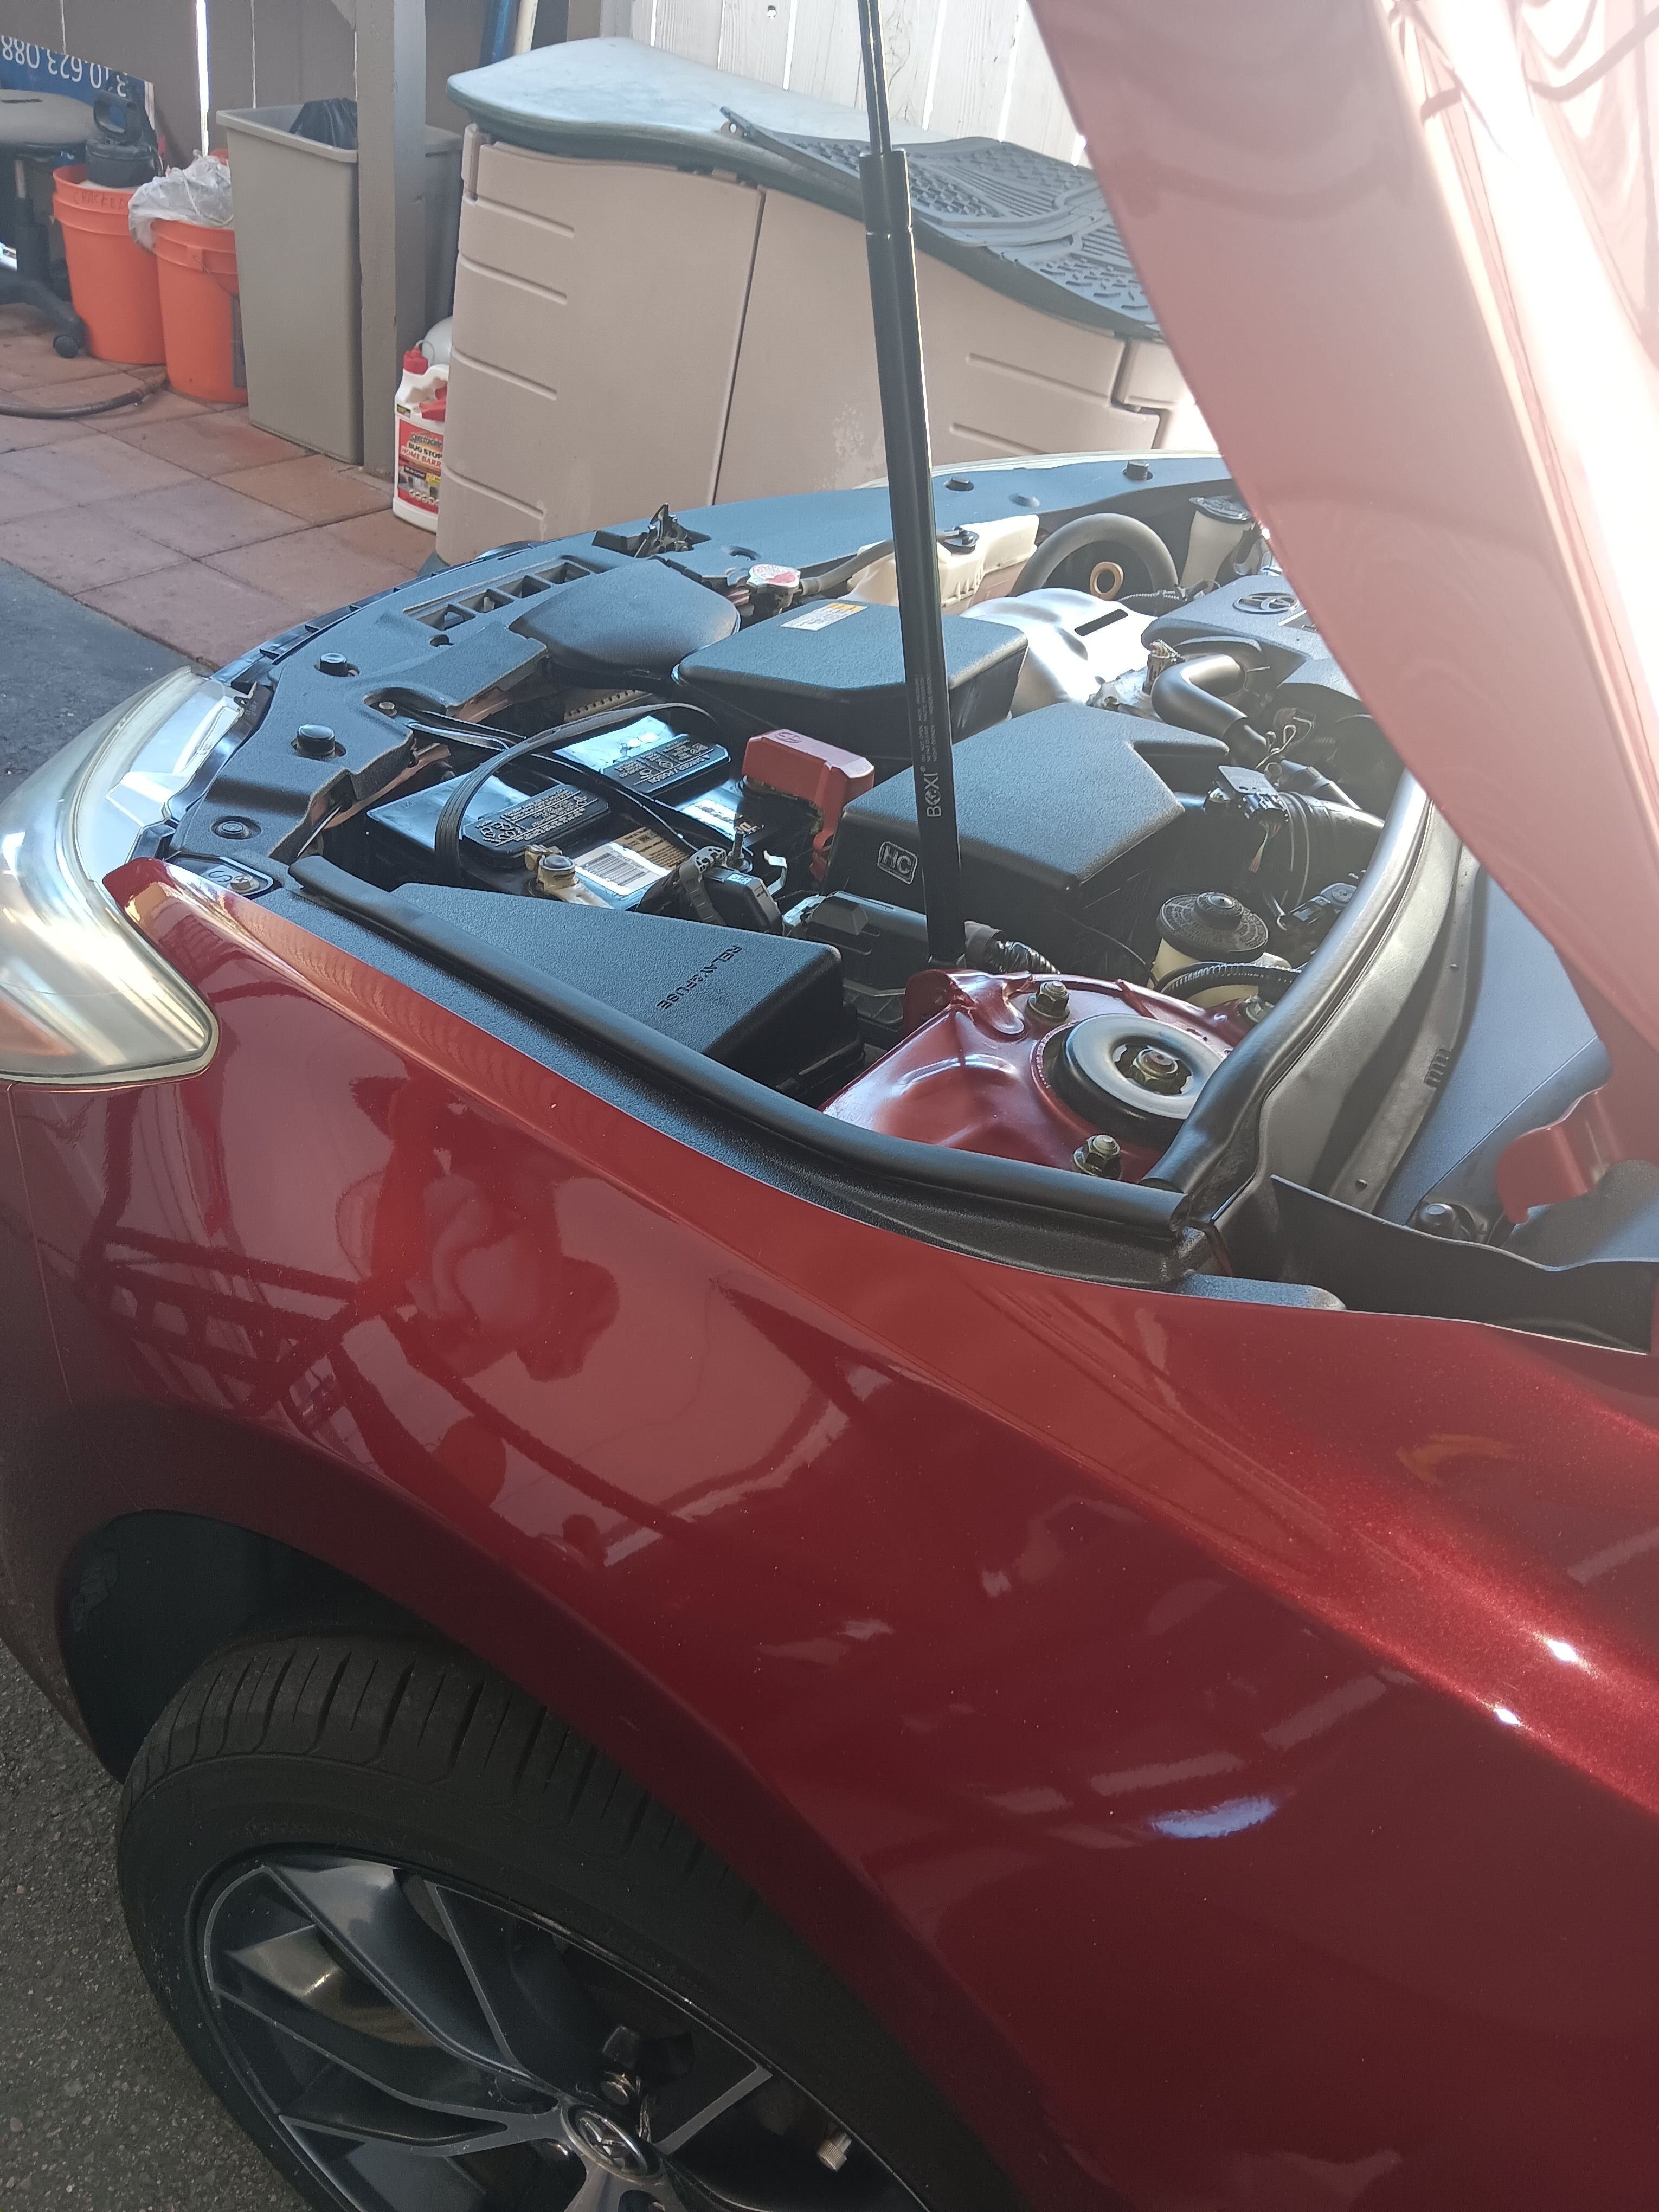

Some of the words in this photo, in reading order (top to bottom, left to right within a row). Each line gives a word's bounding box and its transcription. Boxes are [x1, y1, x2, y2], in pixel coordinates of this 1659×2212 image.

[402, 448, 419, 460] HOME
[409, 442, 422, 453] BUG
[424, 448, 442, 459] STOP
[881, 845, 912, 874] HC
